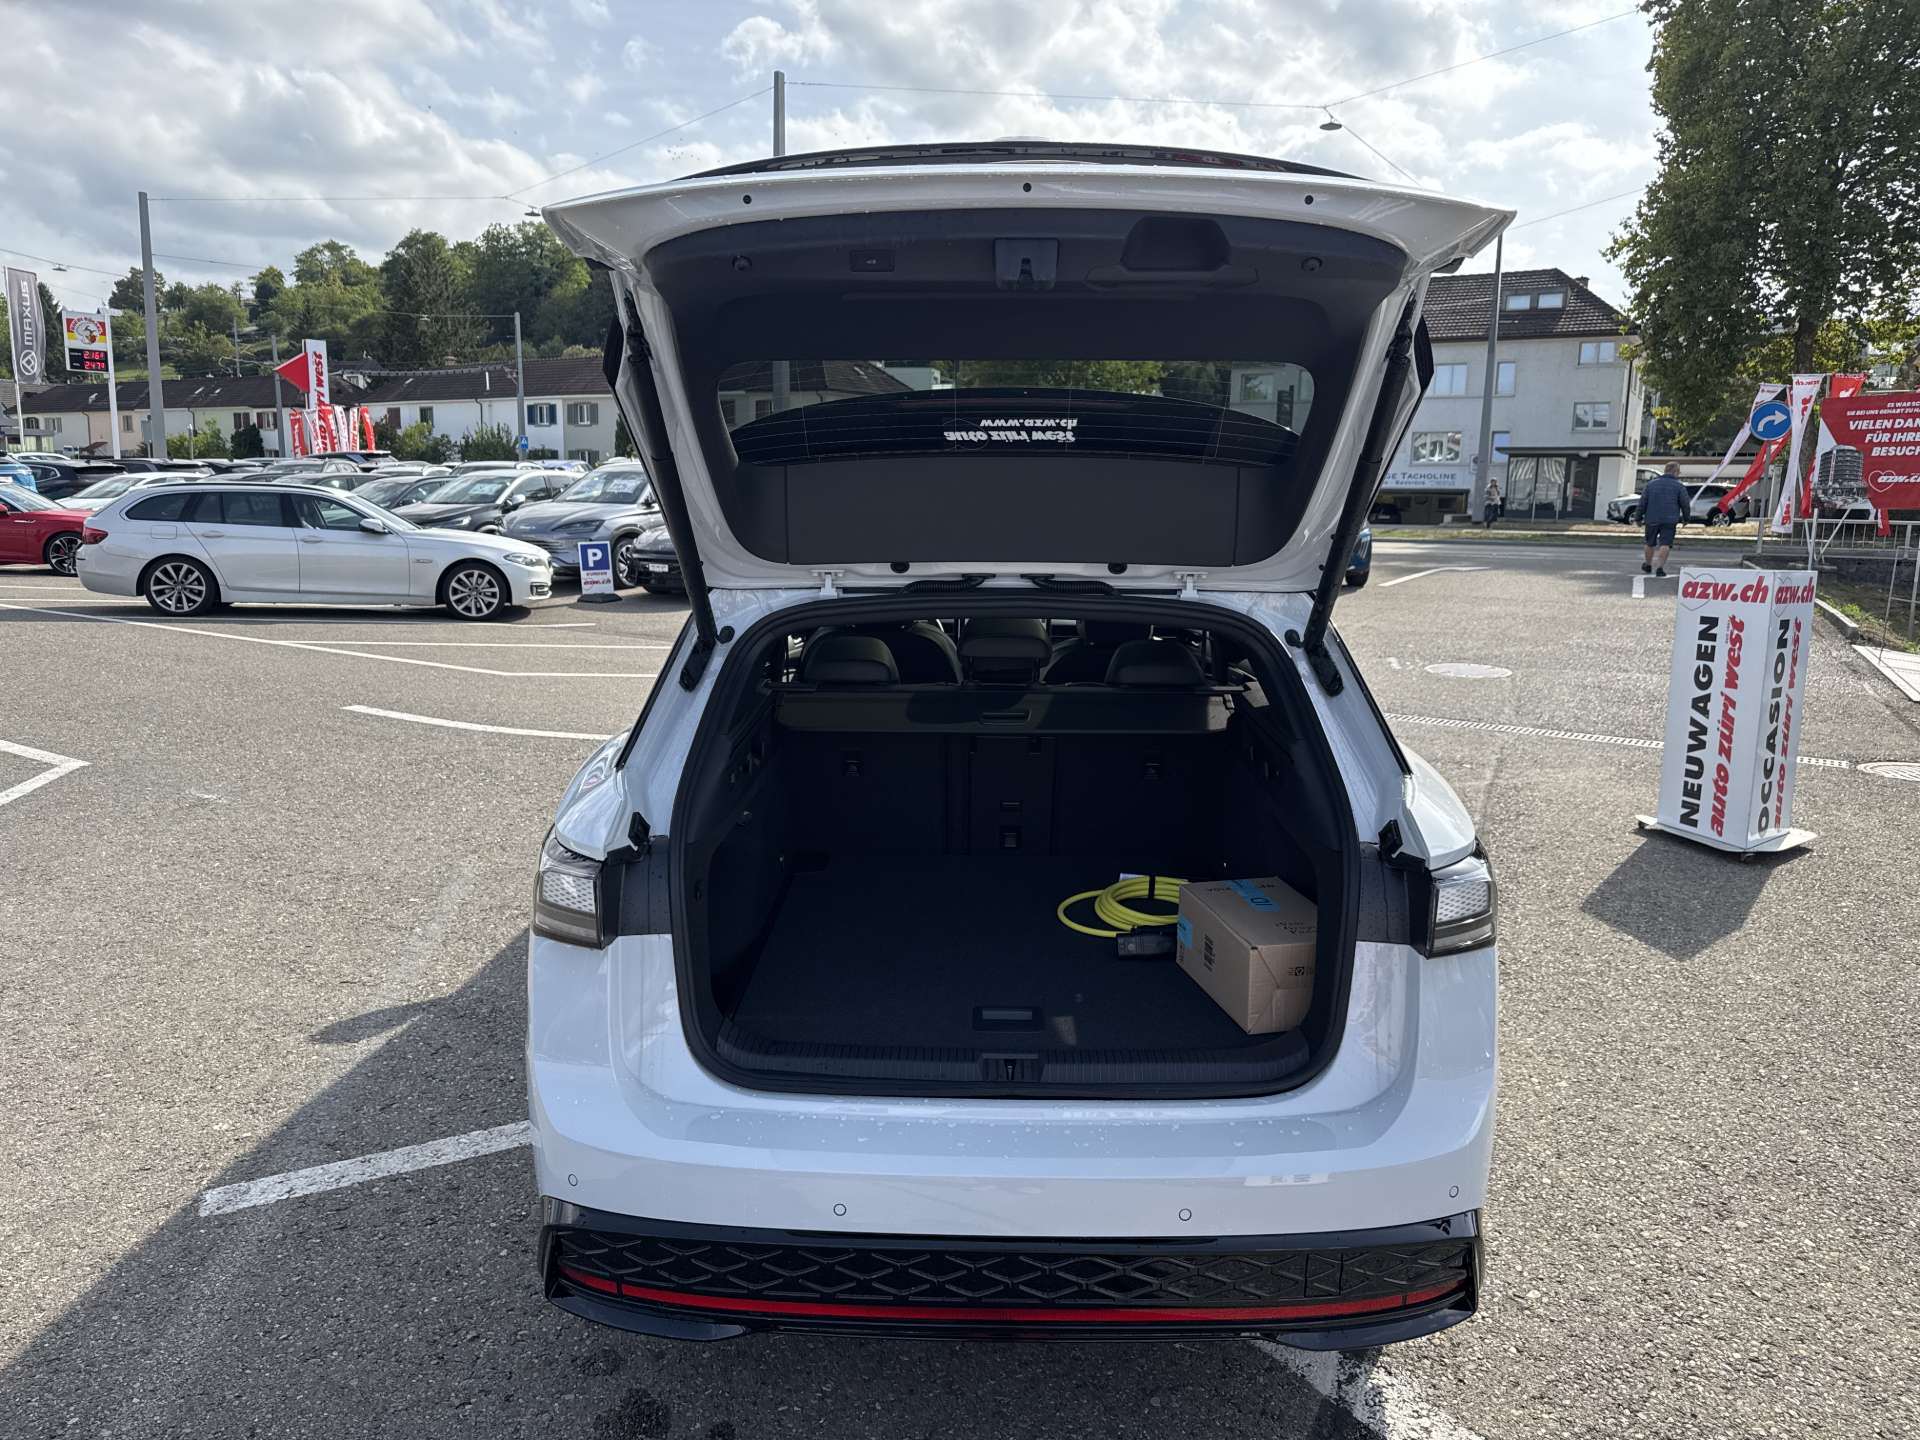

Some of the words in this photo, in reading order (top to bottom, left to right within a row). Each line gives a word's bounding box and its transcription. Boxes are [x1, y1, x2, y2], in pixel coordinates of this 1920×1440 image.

[21, 280, 33, 346] MAXUS
[1849, 419, 1894, 430] VIELEN
[1864, 431, 1891, 443] FÜR
[587, 548, 603, 567] P
[1681, 575, 1770, 604] azw.ch
[1774, 576, 1814, 605] azw.ch
[1724, 614, 1745, 690] west
[1788, 615, 1802, 690] west
[1679, 615, 1719, 828] NEUWAGEN
[1717, 691, 1736, 764] züri
[1757, 619, 1790, 837] OCCASION
[1780, 693, 1793, 760] züri
[1710, 762, 1730, 837] auto
[1774, 763, 1787, 833] auto
